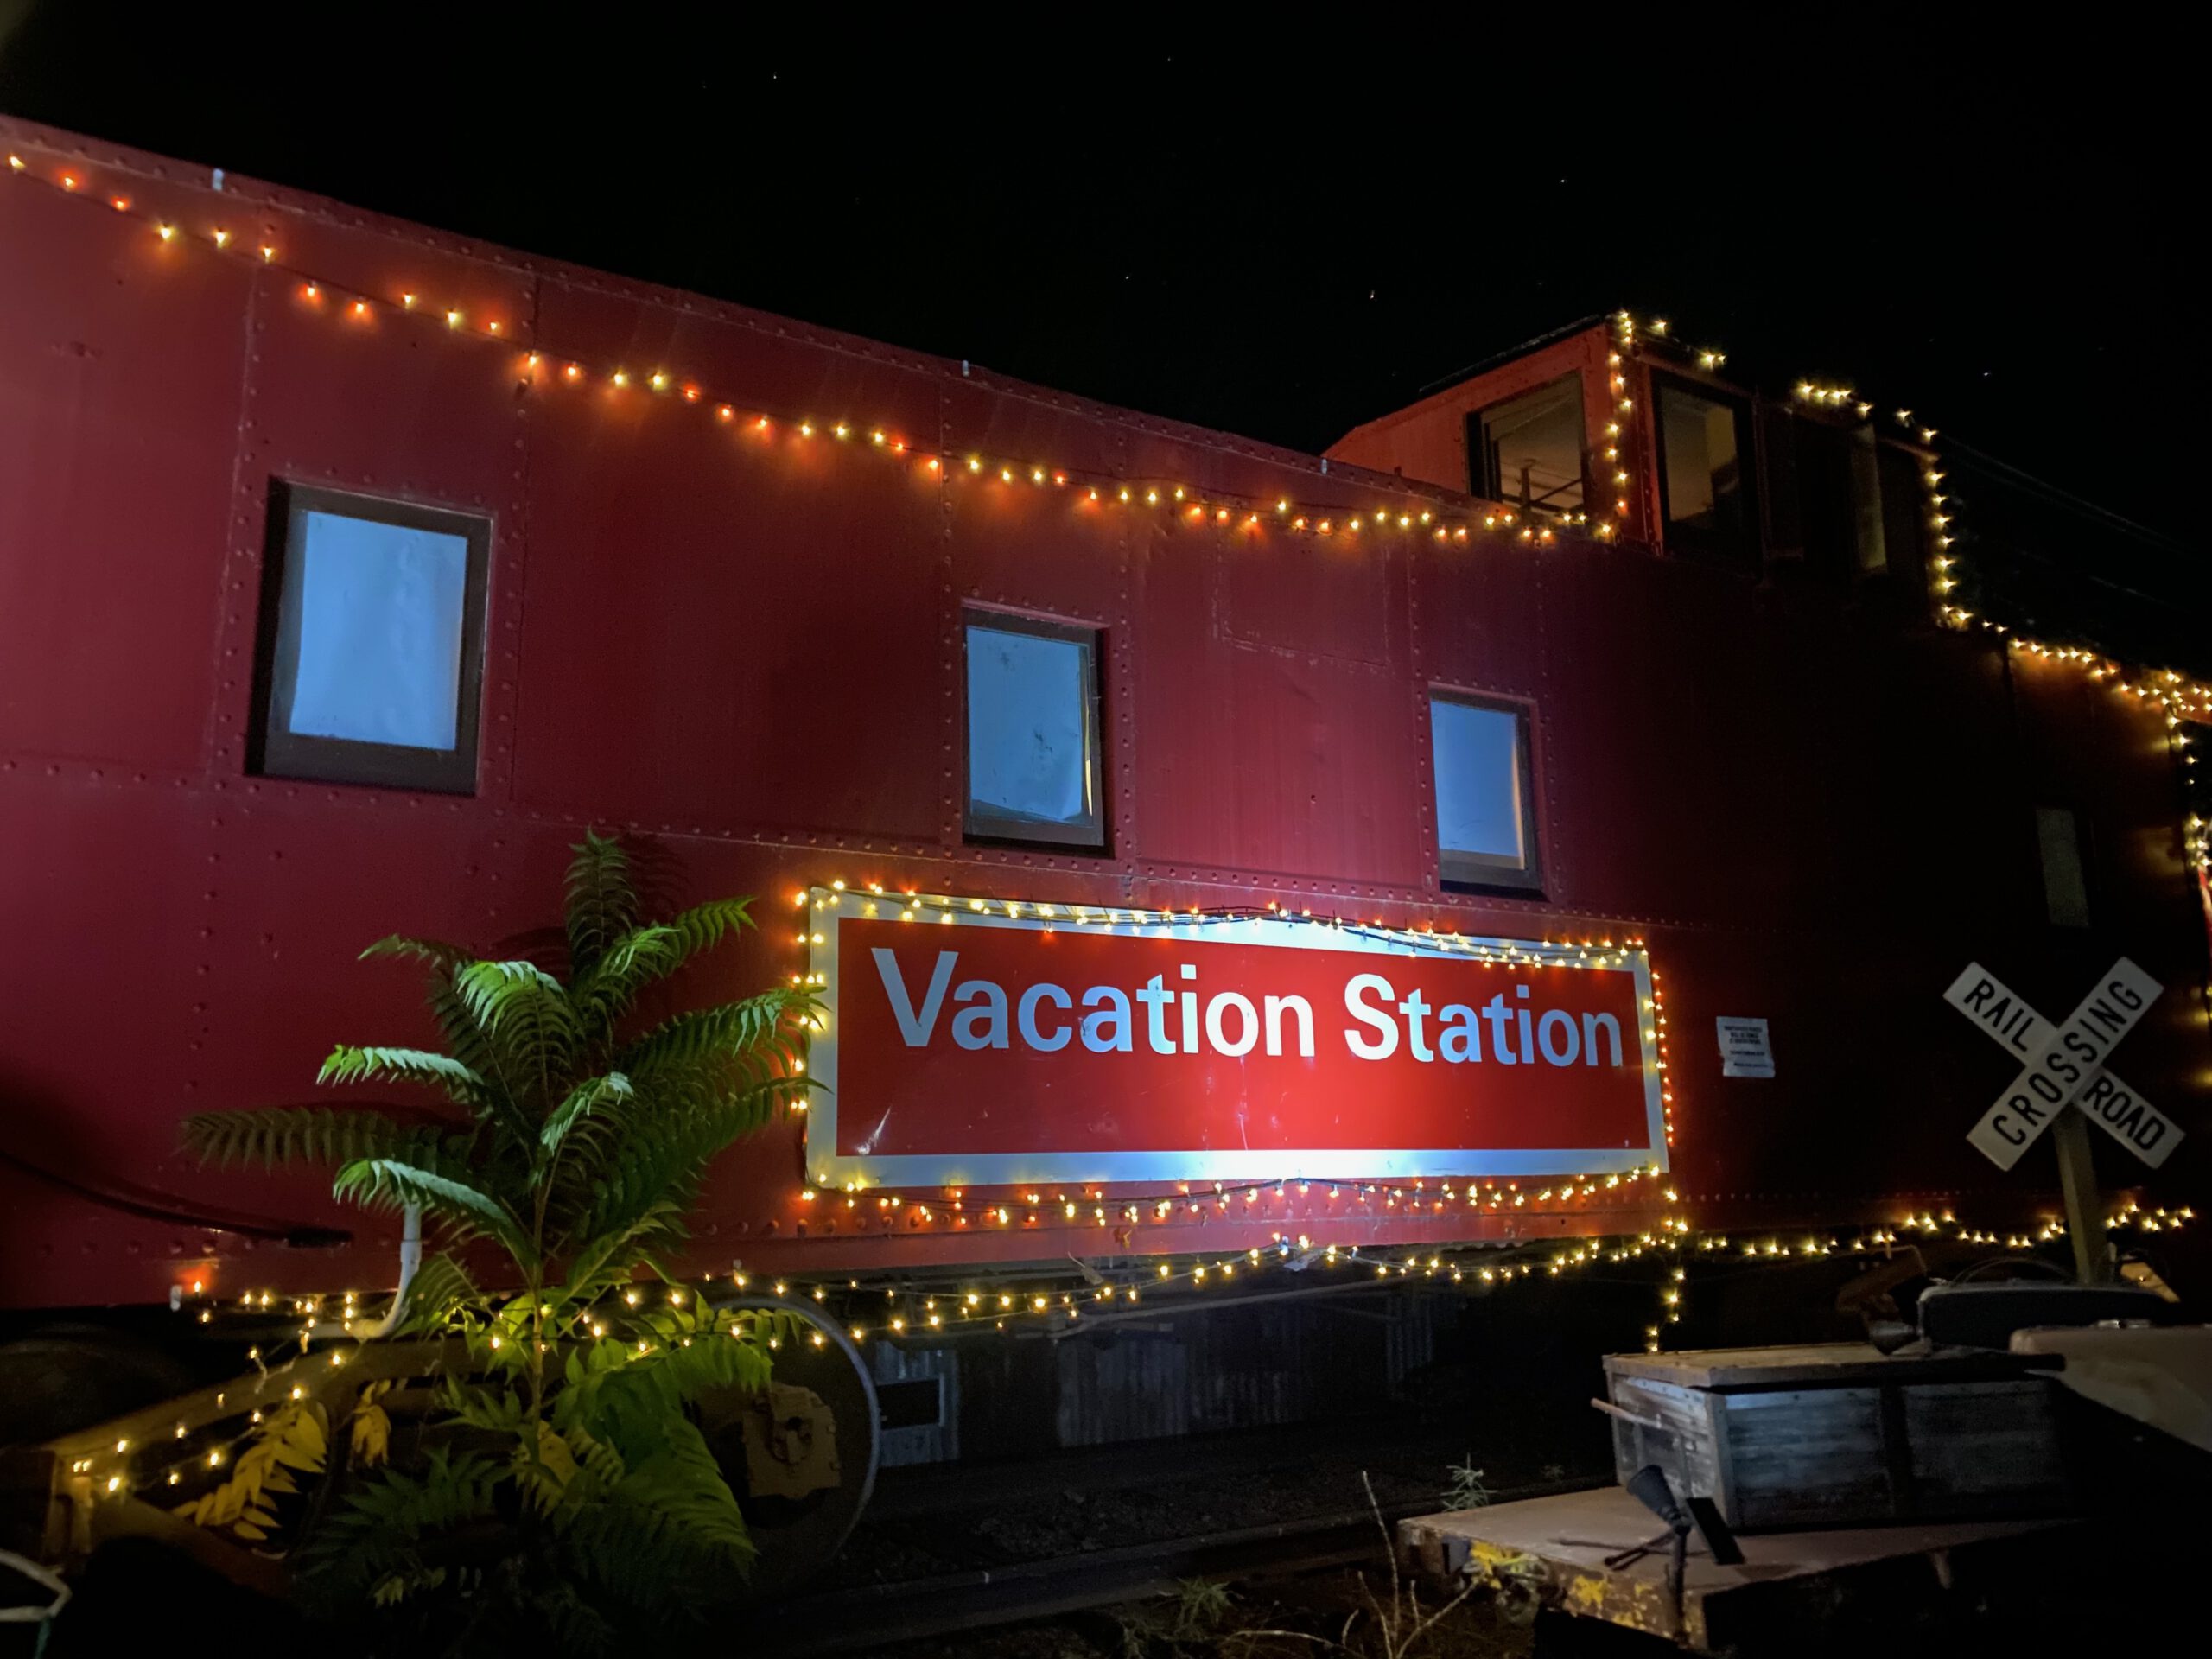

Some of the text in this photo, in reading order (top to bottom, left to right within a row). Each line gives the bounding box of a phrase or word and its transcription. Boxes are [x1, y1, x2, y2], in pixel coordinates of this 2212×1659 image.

[870, 947, 1623, 1067] Vacation Station
[1963, 979, 2166, 1151] RAIL ROAD
[1992, 981, 2143, 1146] CROSSING
